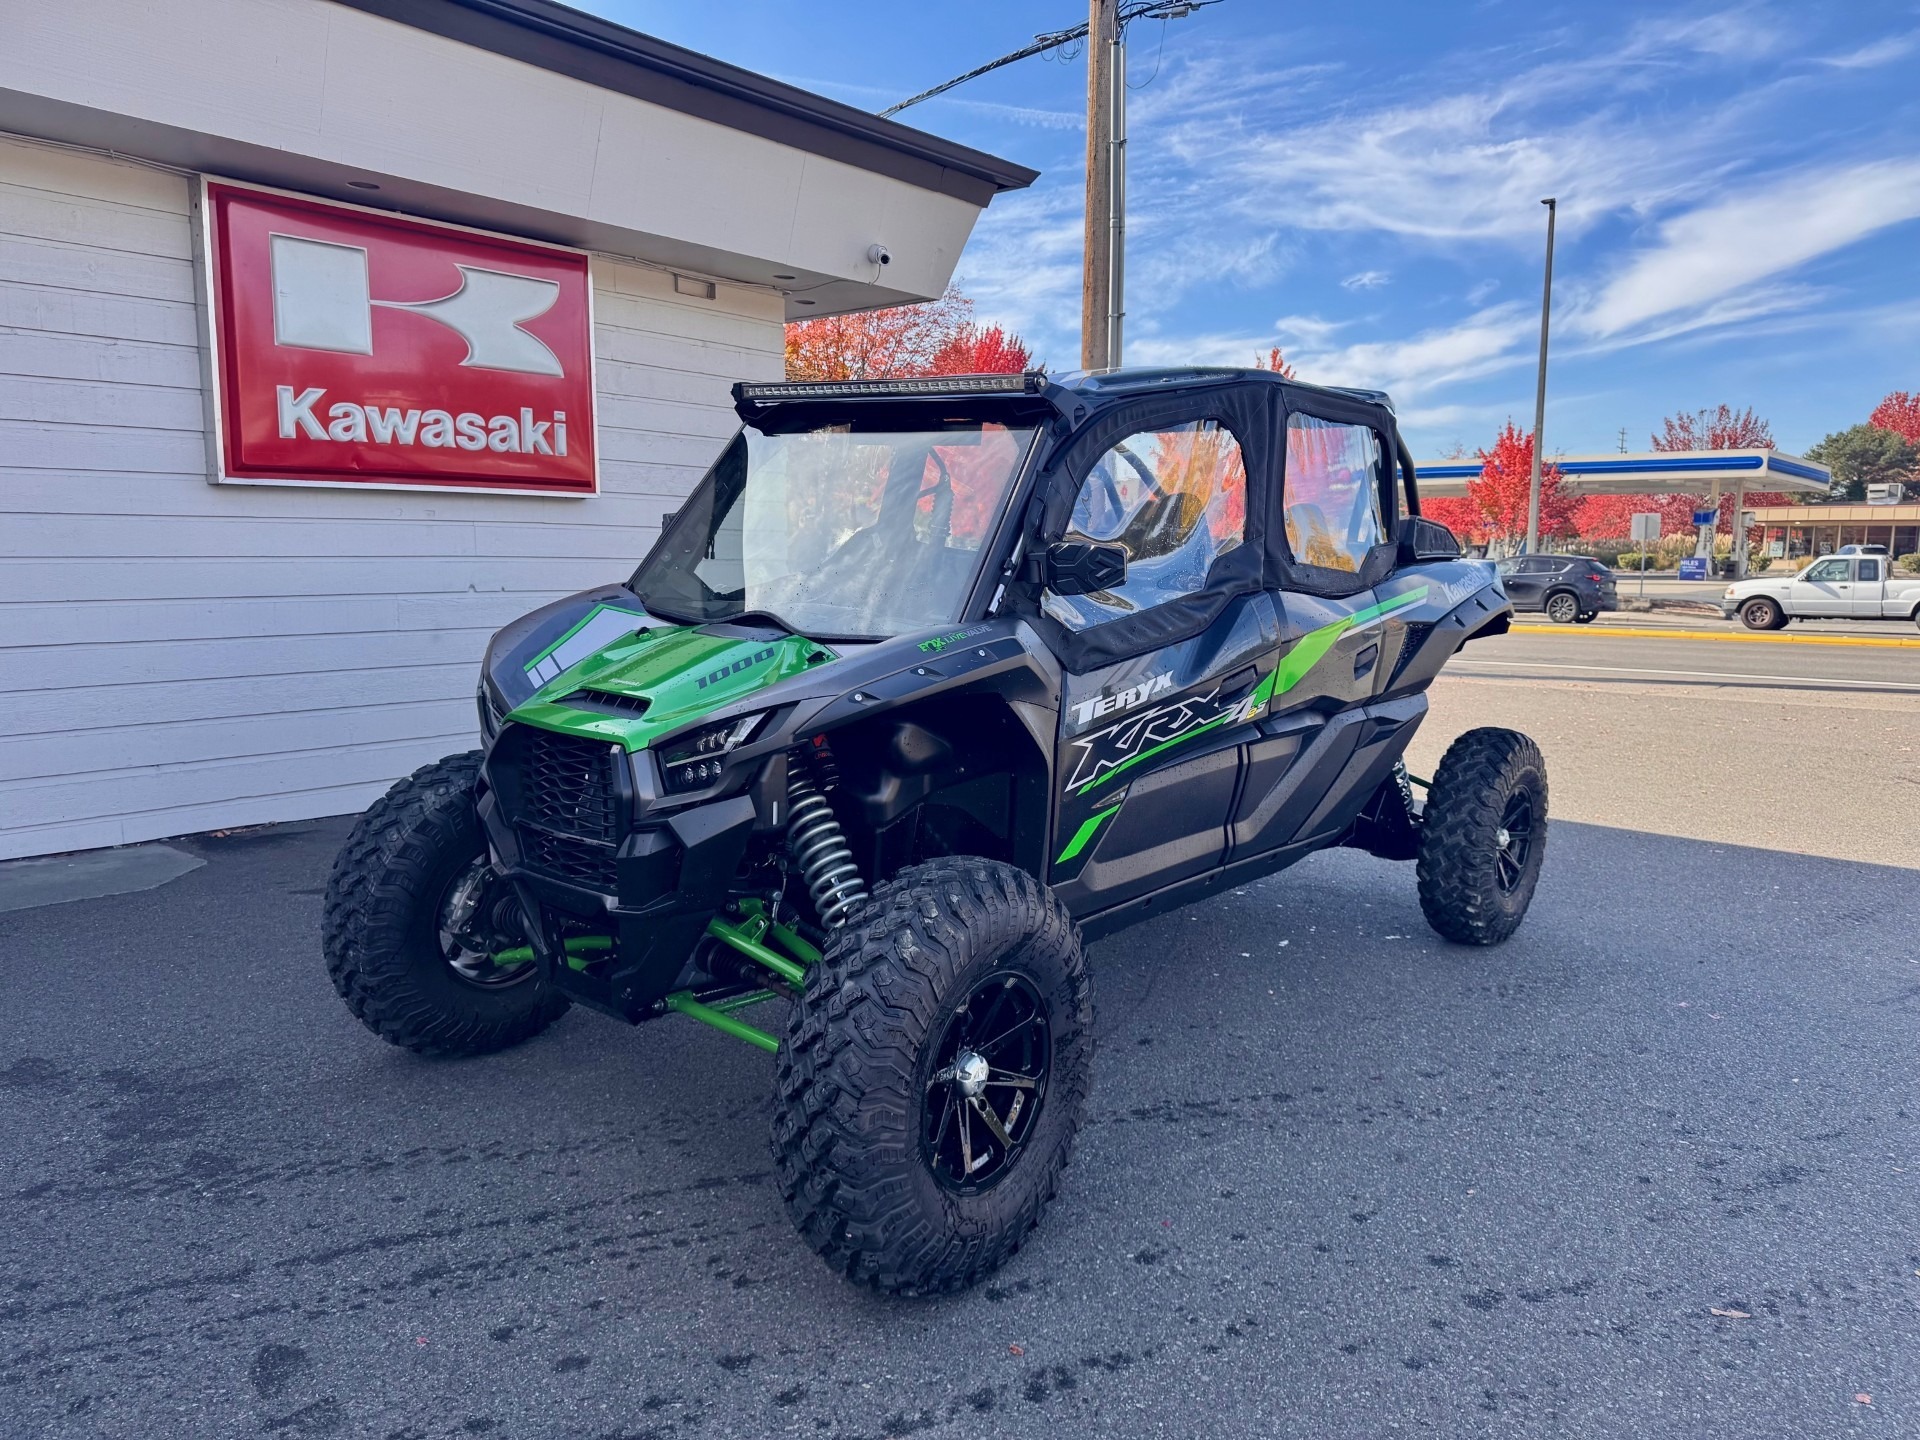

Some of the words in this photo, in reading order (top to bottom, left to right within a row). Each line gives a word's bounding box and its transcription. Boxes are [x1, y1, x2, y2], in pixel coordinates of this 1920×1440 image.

[276, 384, 567, 457] Kawasaki
[1441, 566, 1484, 604] Kawasaki
[917, 637, 946, 652] FOX
[695, 647, 775, 690] 1000
[1071, 669, 1174, 726] TERYX
